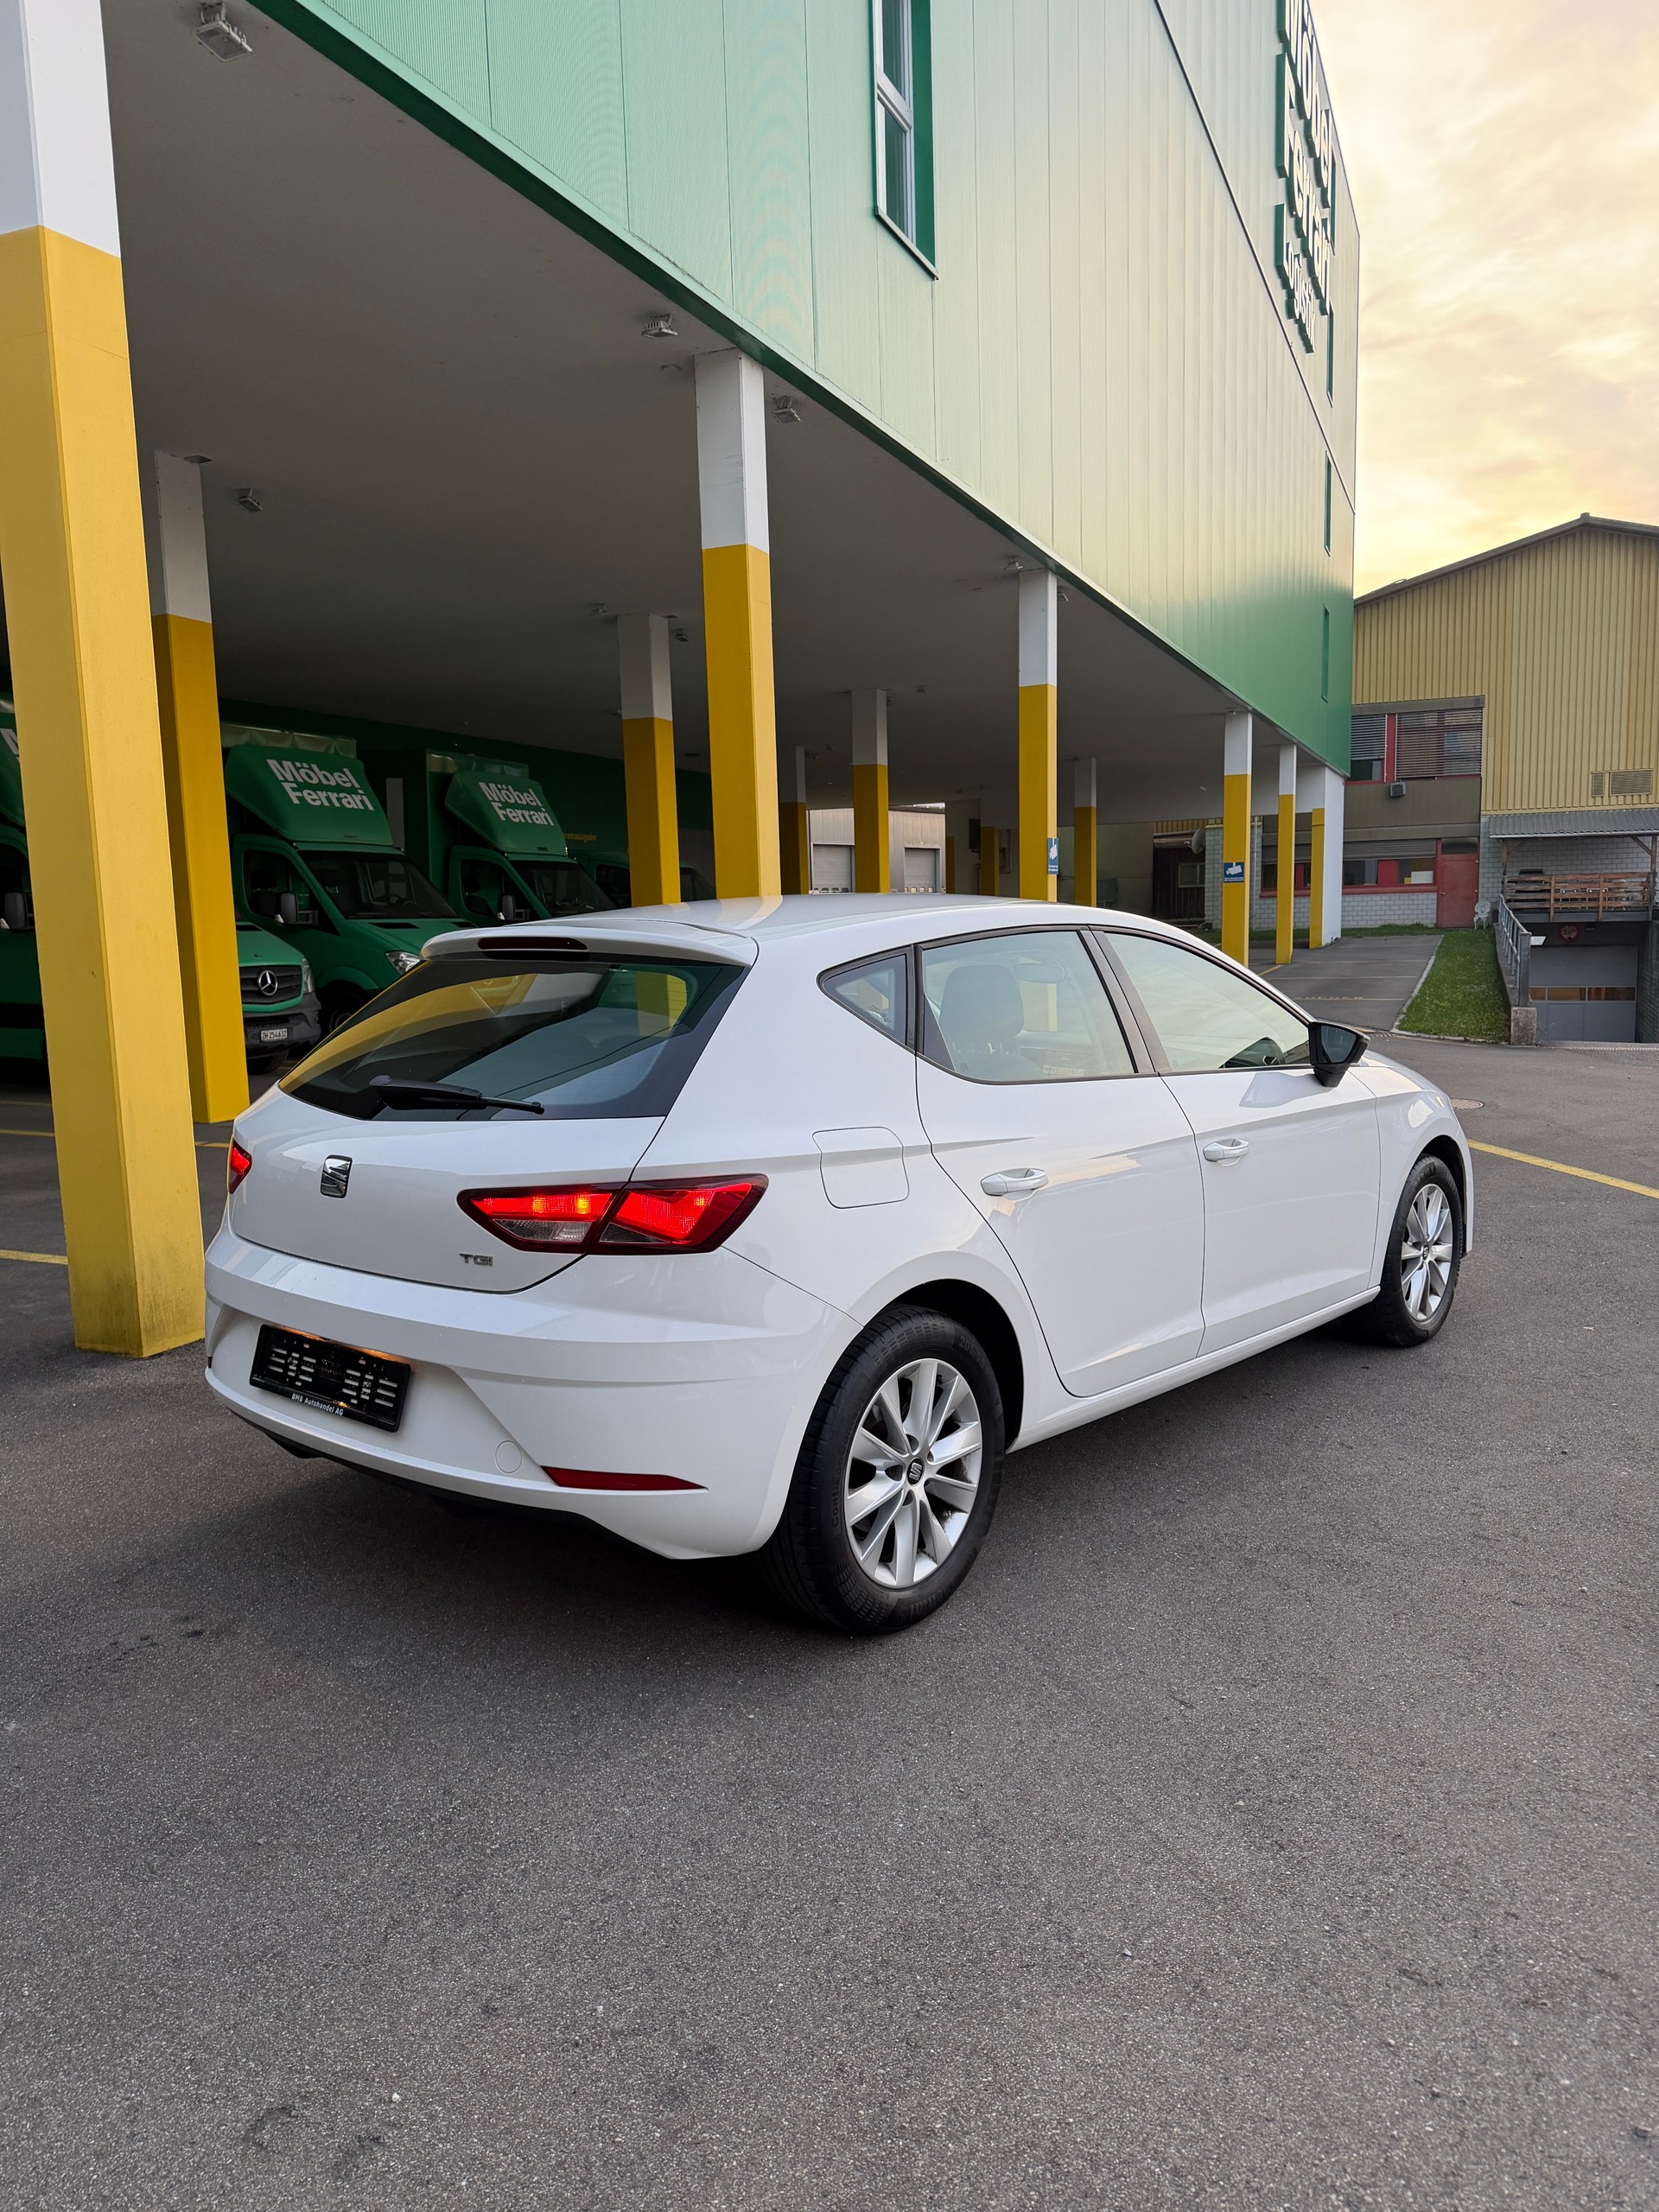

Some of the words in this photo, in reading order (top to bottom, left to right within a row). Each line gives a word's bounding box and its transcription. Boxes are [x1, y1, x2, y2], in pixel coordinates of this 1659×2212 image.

[1283, 52, 1332, 316] Ferrari
[266, 759, 361, 789] Möbel
[281, 781, 375, 811] Ferrari
[478, 781, 543, 807] Möbel
[491, 801, 555, 826] Ferrari
[459, 1253, 493, 1267] TGI
[291, 1392, 303, 1402] BMB
[303, 1397, 335, 1414] Autohandel
[334, 1408, 344, 1416] AG
